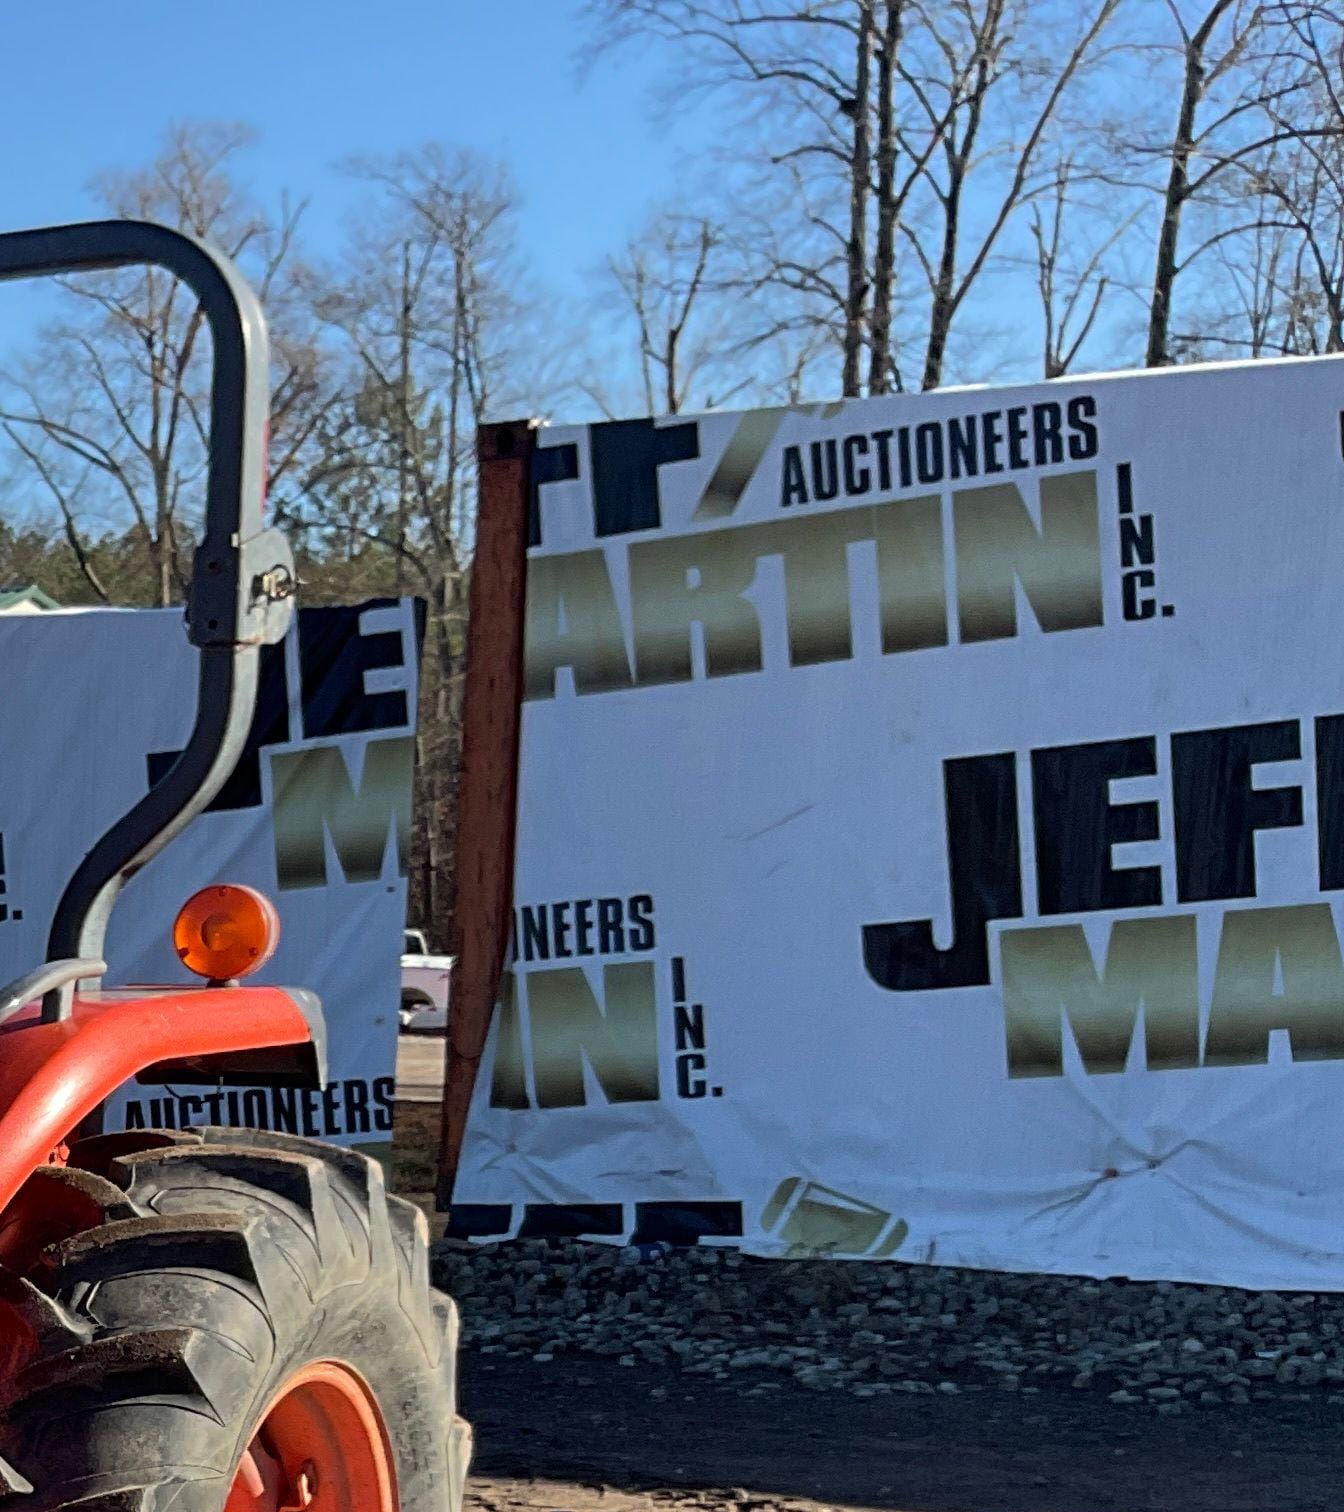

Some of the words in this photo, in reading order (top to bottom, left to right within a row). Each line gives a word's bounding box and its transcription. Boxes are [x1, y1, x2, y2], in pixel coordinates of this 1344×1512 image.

[781, 396, 1099, 508] AUCTIONEERS
[1115, 462, 1175, 622] INC.
[861, 714, 1344, 994] JEF
[671, 957, 723, 1098] INC.
